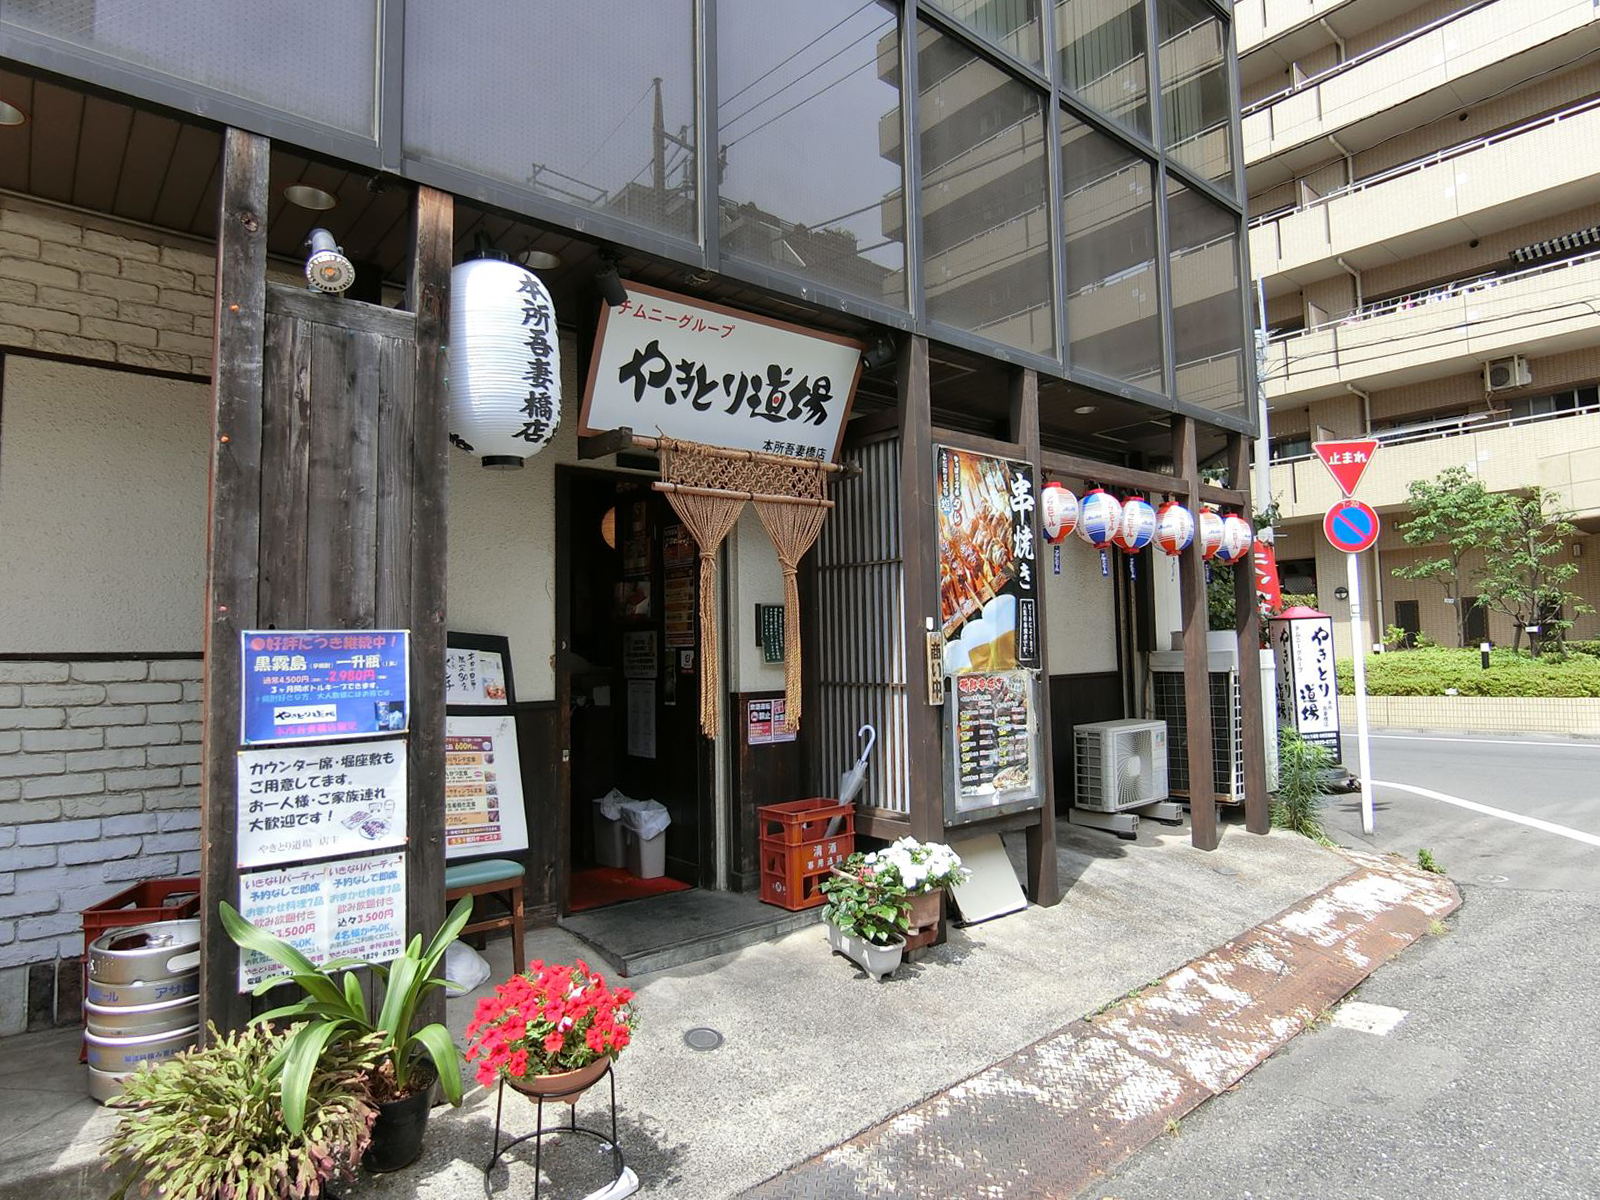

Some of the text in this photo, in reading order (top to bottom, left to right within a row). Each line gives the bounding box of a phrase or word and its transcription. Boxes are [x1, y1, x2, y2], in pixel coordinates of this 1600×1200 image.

[618, 301, 735, 339] チムニーグループ
[512, 274, 553, 444] 本所吾妻橋店
[619, 339, 833, 426] やきとり道場
[763, 440, 827, 460] 本所吾妻橋店
[1329, 451, 1367, 465] 止まれ
[1009, 473, 1035, 590] 串焼き
[254, 655, 307, 672] 黒霧島
[931, 642, 941, 699] 商い中
[1311, 626, 1329, 697] やきとり
[1300, 684, 1319, 721] 道場
[250, 774, 352, 793] ご用意してます。
[250, 788, 386, 813] お一人様・ご家族連れ
[249, 811, 333, 832] 大歓迎です！
